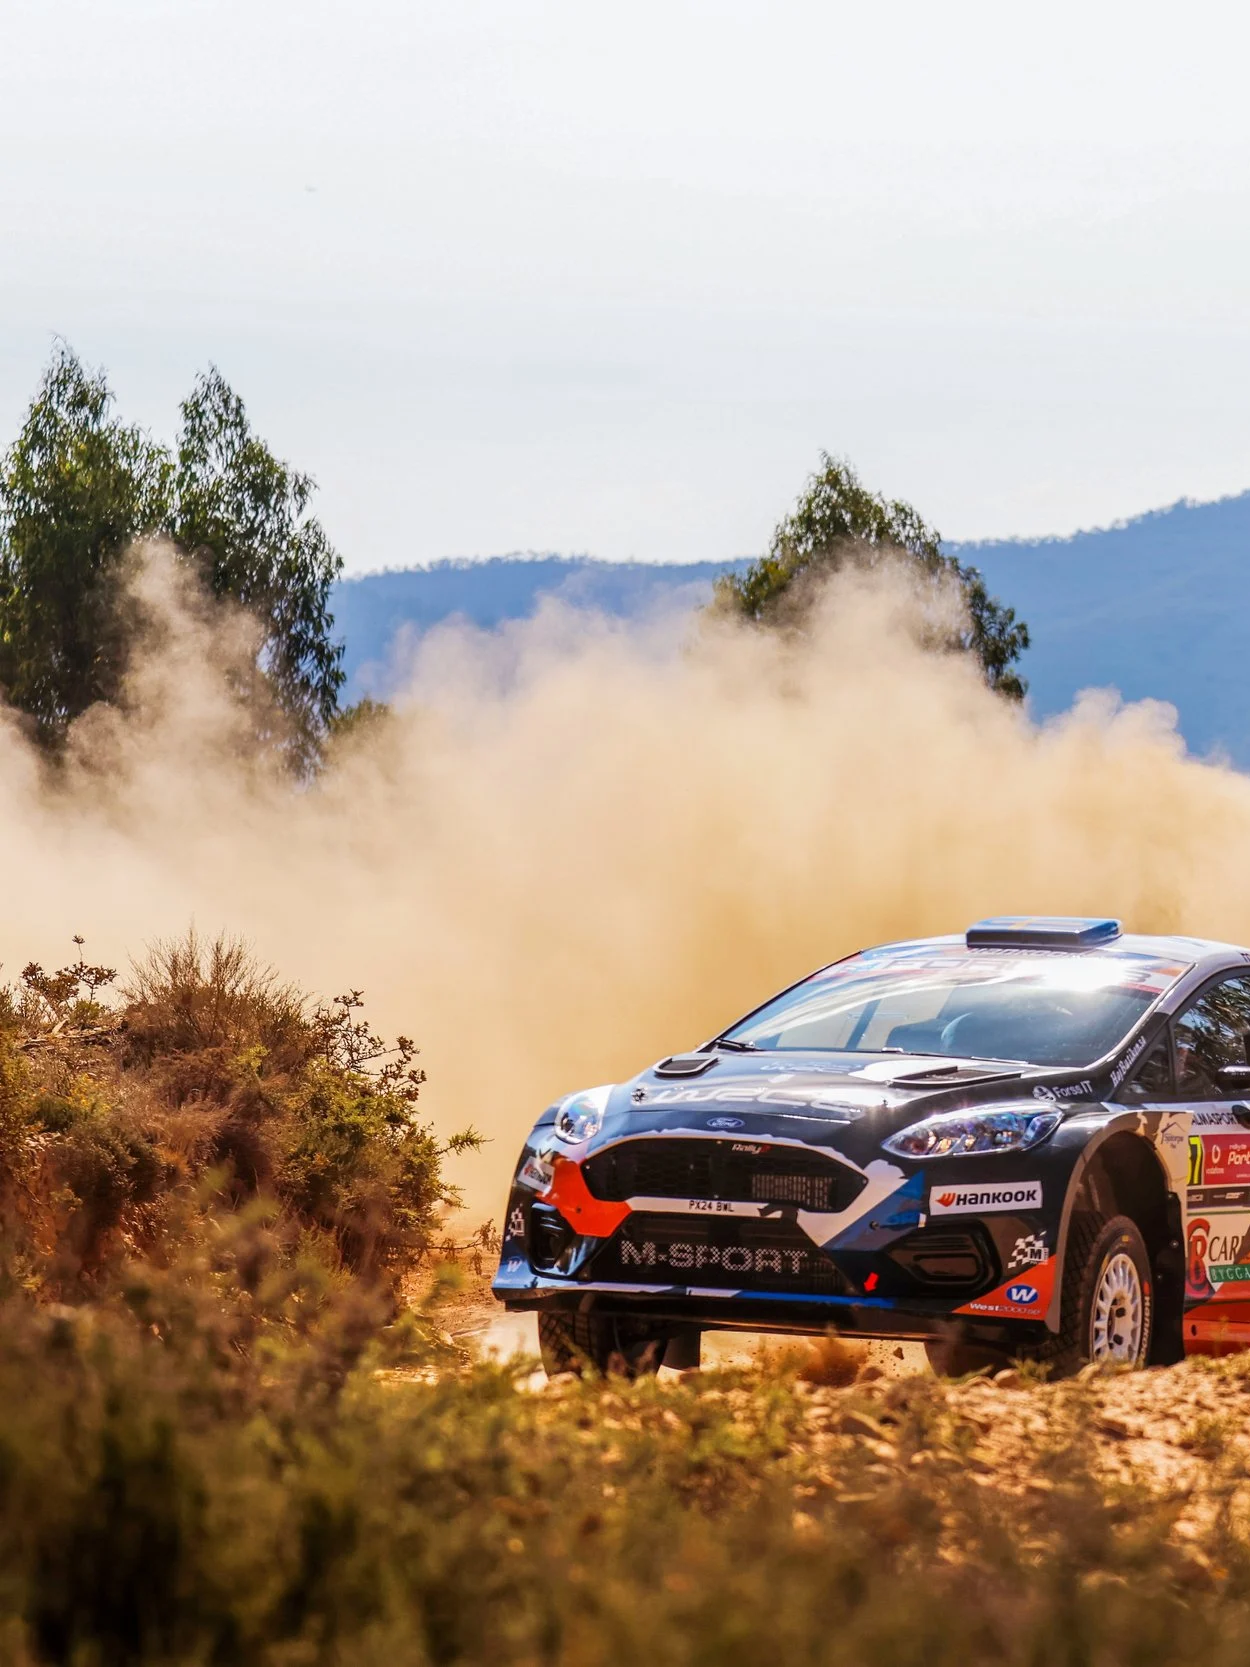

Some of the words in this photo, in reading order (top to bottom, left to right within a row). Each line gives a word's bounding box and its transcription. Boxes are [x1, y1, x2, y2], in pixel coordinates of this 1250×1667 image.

[1081, 1080, 1093, 1093] IT
[689, 1200, 713, 1212] PX24
[716, 1201, 735, 1213] BWL
[1010, 1288, 1038, 1302] W
[1140, 1296, 1152, 1361] HANKOO
